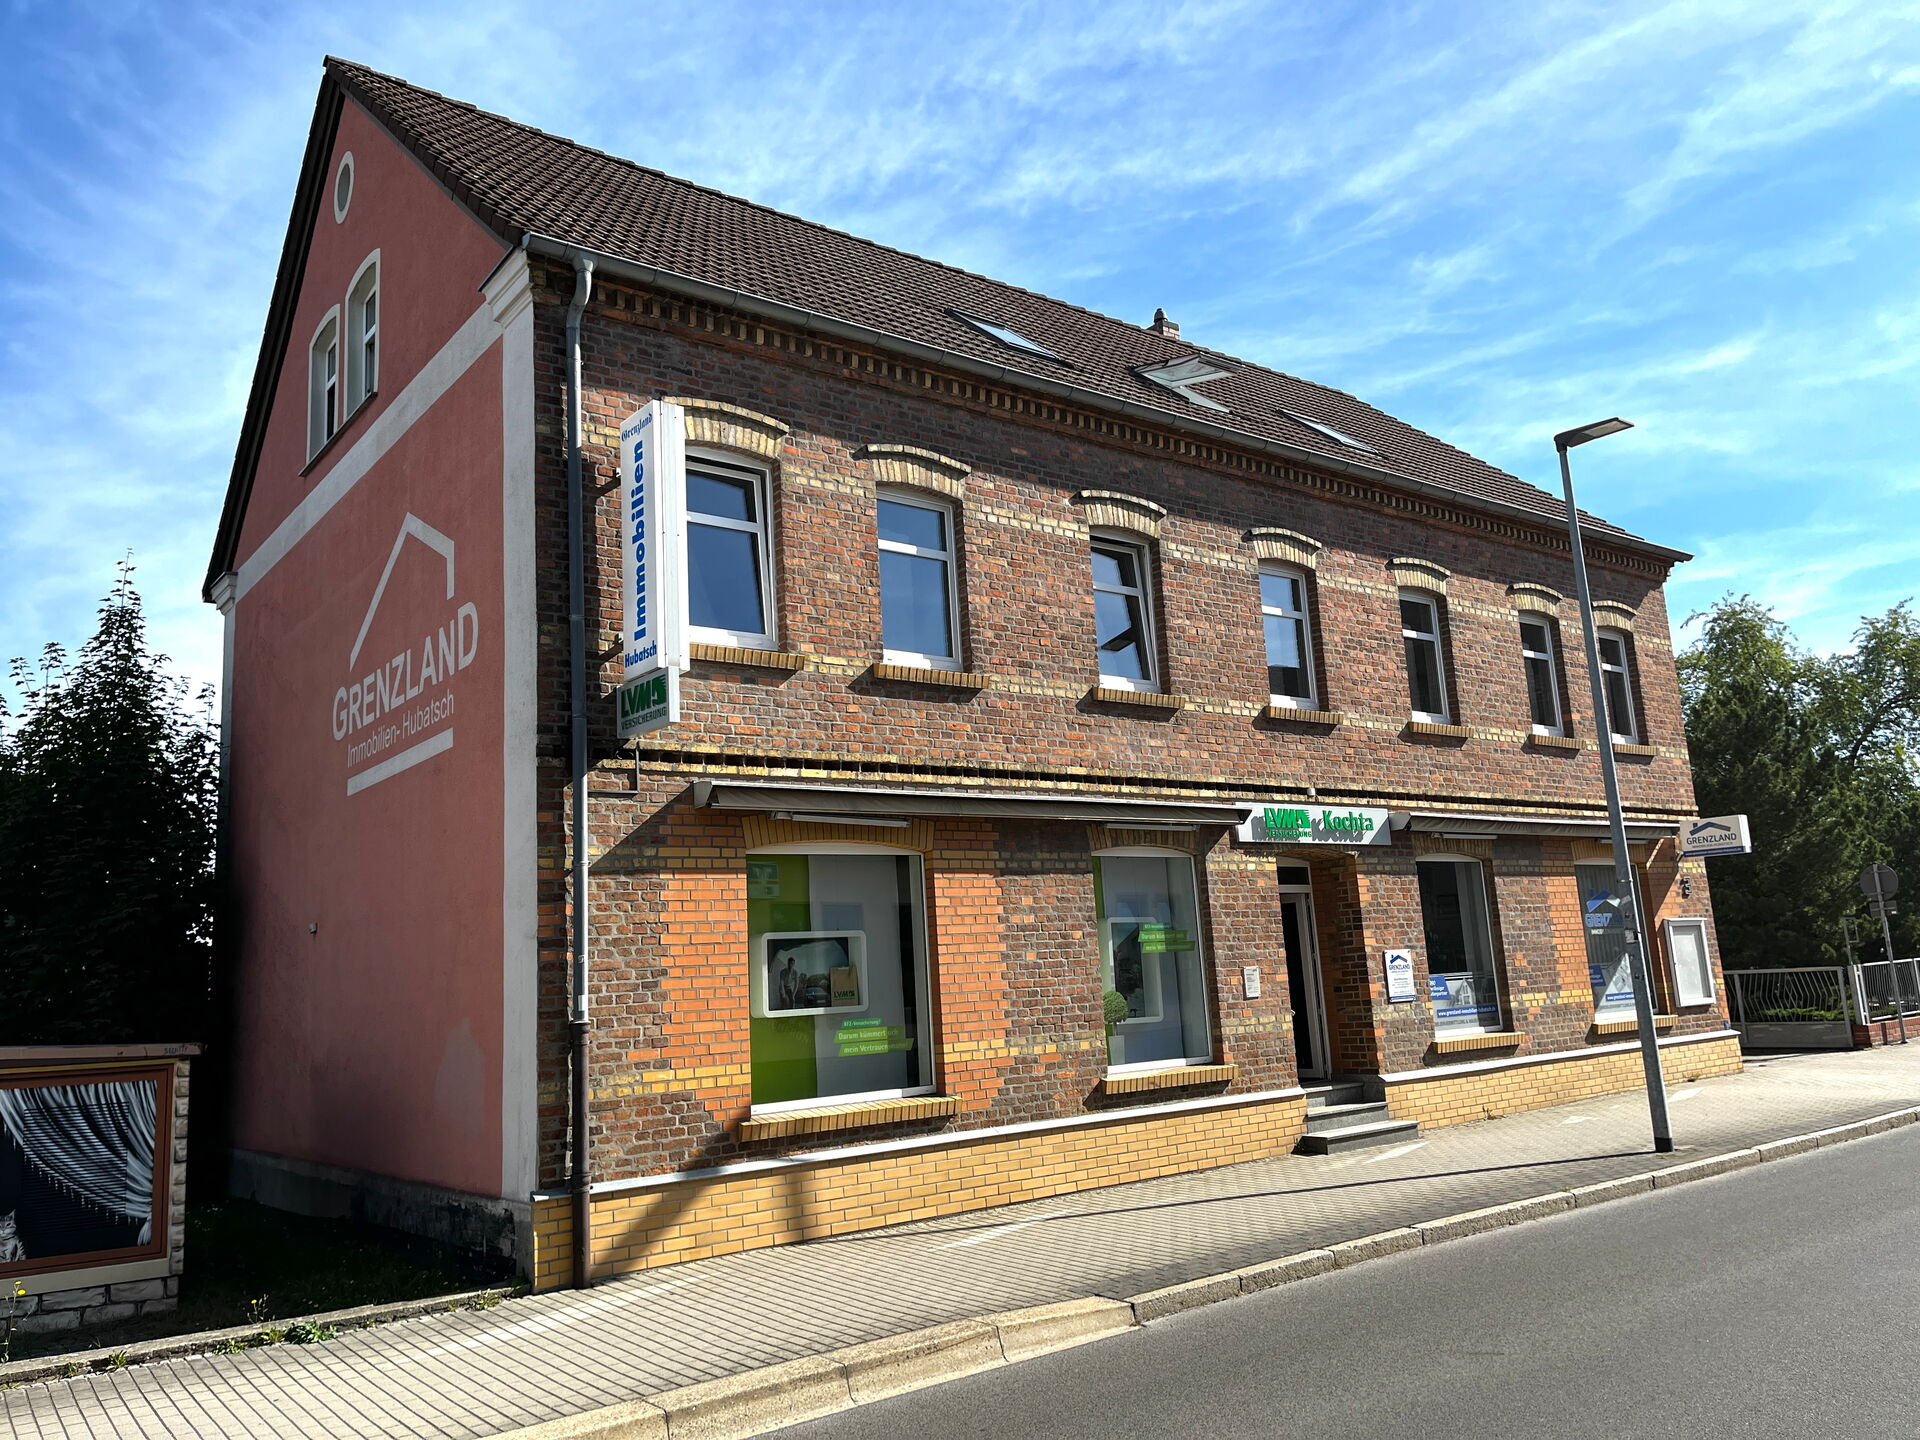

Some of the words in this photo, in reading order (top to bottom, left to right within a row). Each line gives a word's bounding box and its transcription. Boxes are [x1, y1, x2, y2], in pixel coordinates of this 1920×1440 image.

[631, 440, 646, 641] Immobilien
[624, 640, 657, 668] Hubatsch
[332, 601, 479, 741] GRENZLAND
[402, 689, 454, 740] Hubatsch
[621, 706, 667, 730] VERSICHERUNG
[1322, 810, 1375, 831] Kochta
[1686, 832, 1737, 845] GRENZLAND
